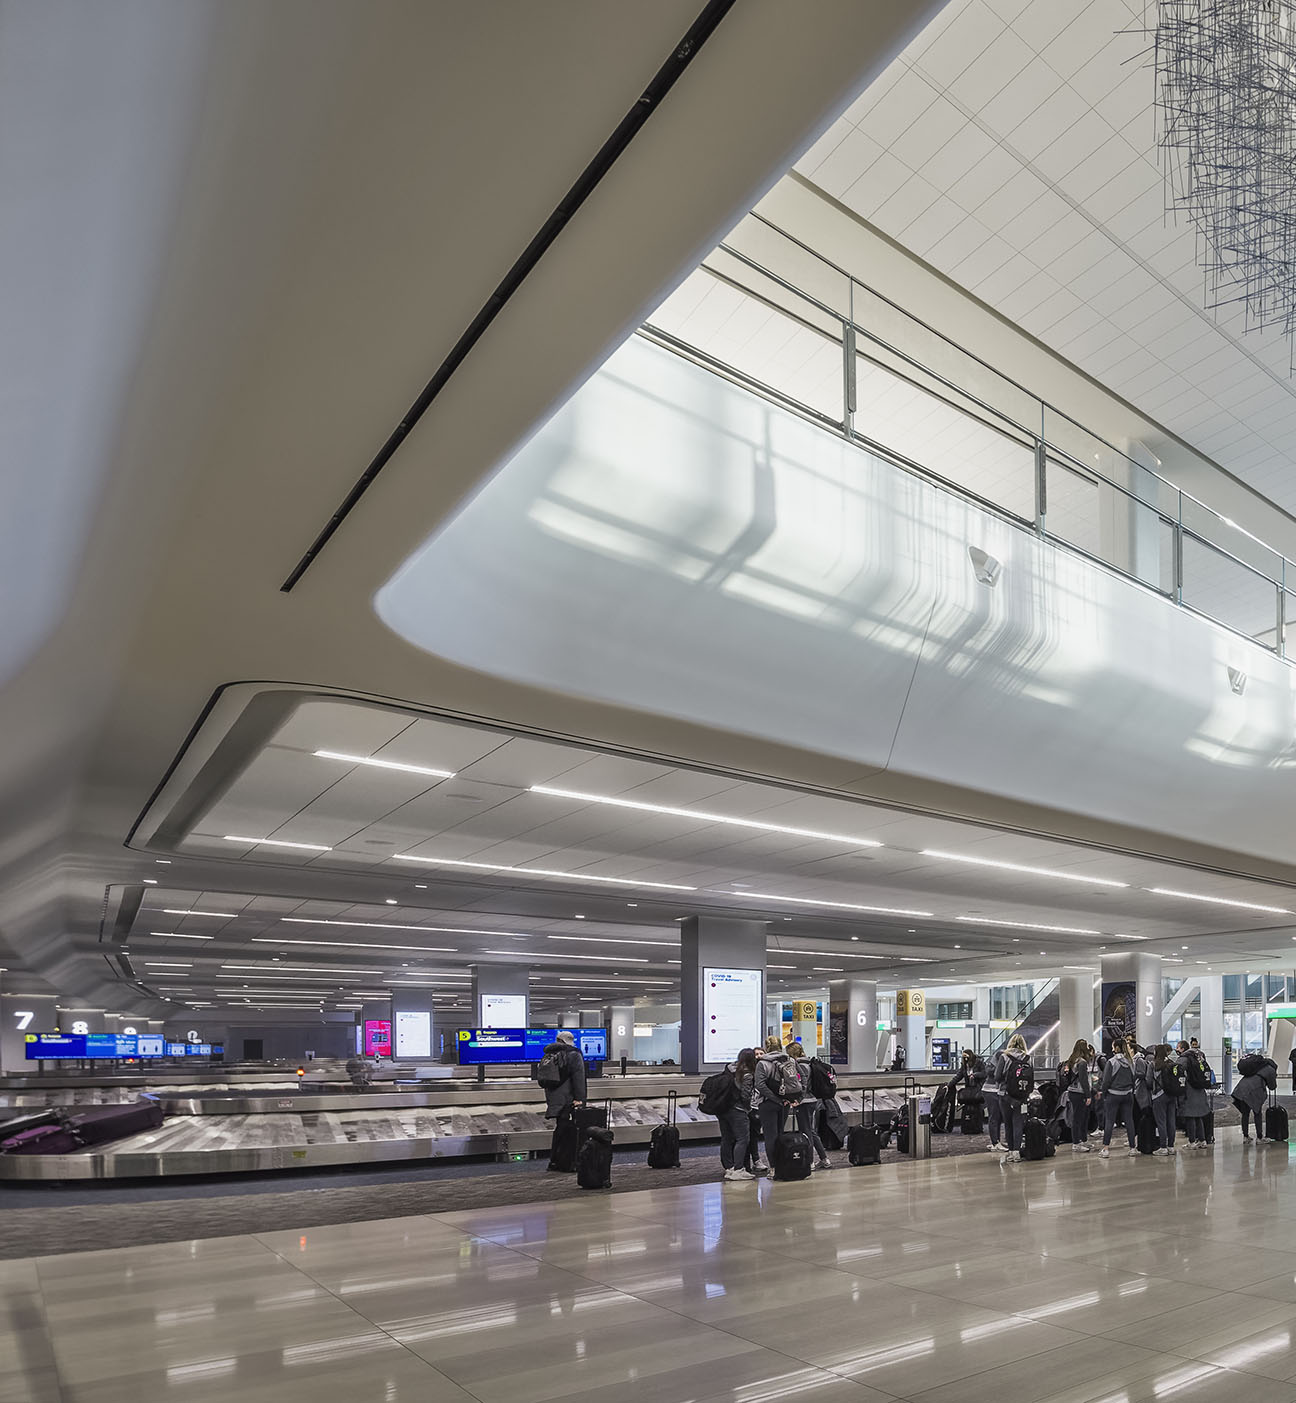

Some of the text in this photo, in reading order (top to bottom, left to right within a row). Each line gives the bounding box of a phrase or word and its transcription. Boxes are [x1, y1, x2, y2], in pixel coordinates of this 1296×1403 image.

[1145, 995, 1154, 1017] 5
[13, 1011, 34, 1030] 7
[857, 1010, 867, 1026] 6
[617, 1025, 626, 1036] 8
